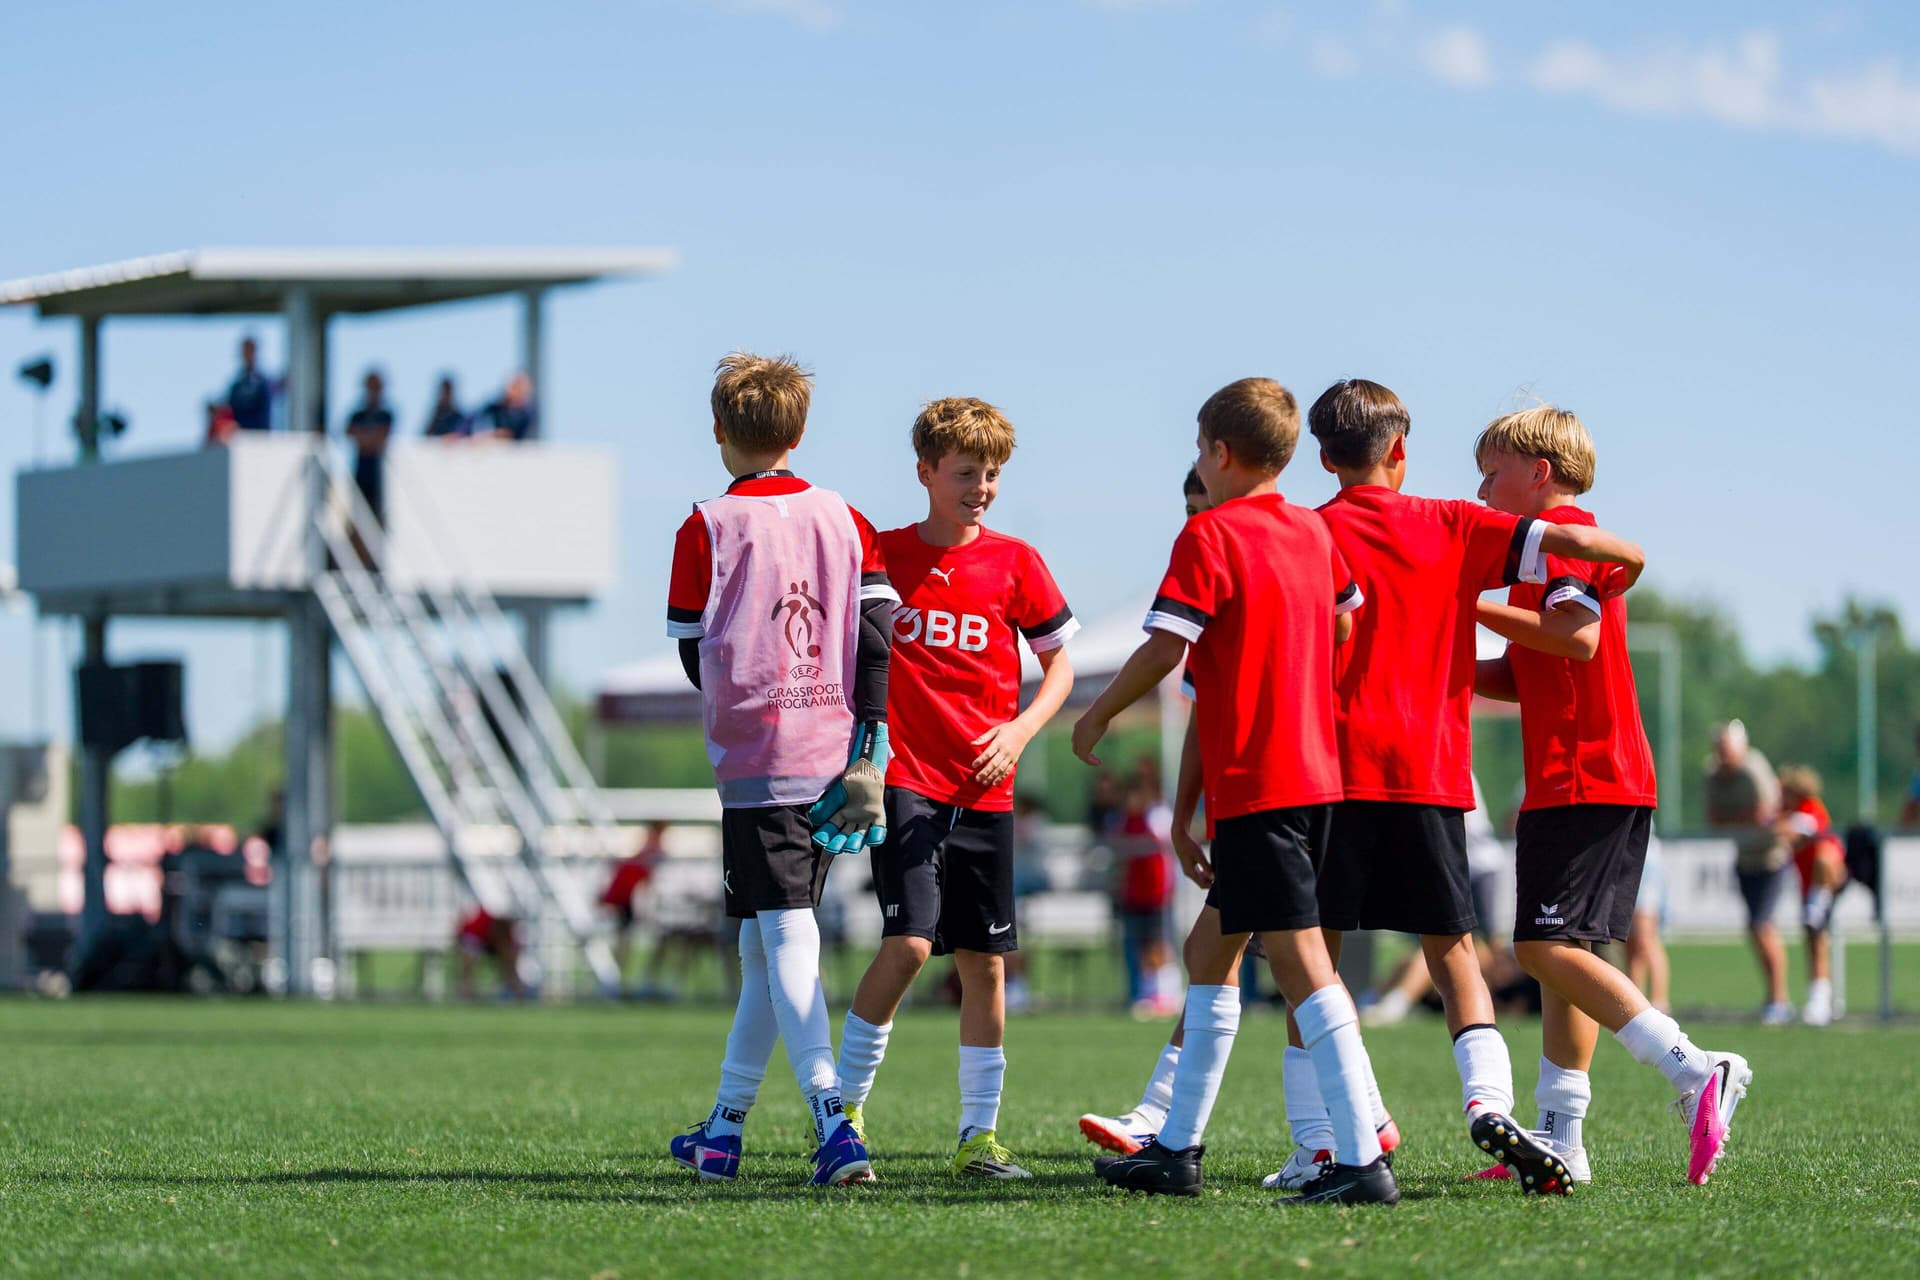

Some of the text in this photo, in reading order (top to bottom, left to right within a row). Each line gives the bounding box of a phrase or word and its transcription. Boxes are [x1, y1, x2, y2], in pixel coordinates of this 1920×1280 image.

[892, 607, 989, 652] ÖBB
[791, 667, 820, 679] UEFA
[768, 695, 846, 711] PROGRAMME
[1535, 915, 1564, 925] erima
